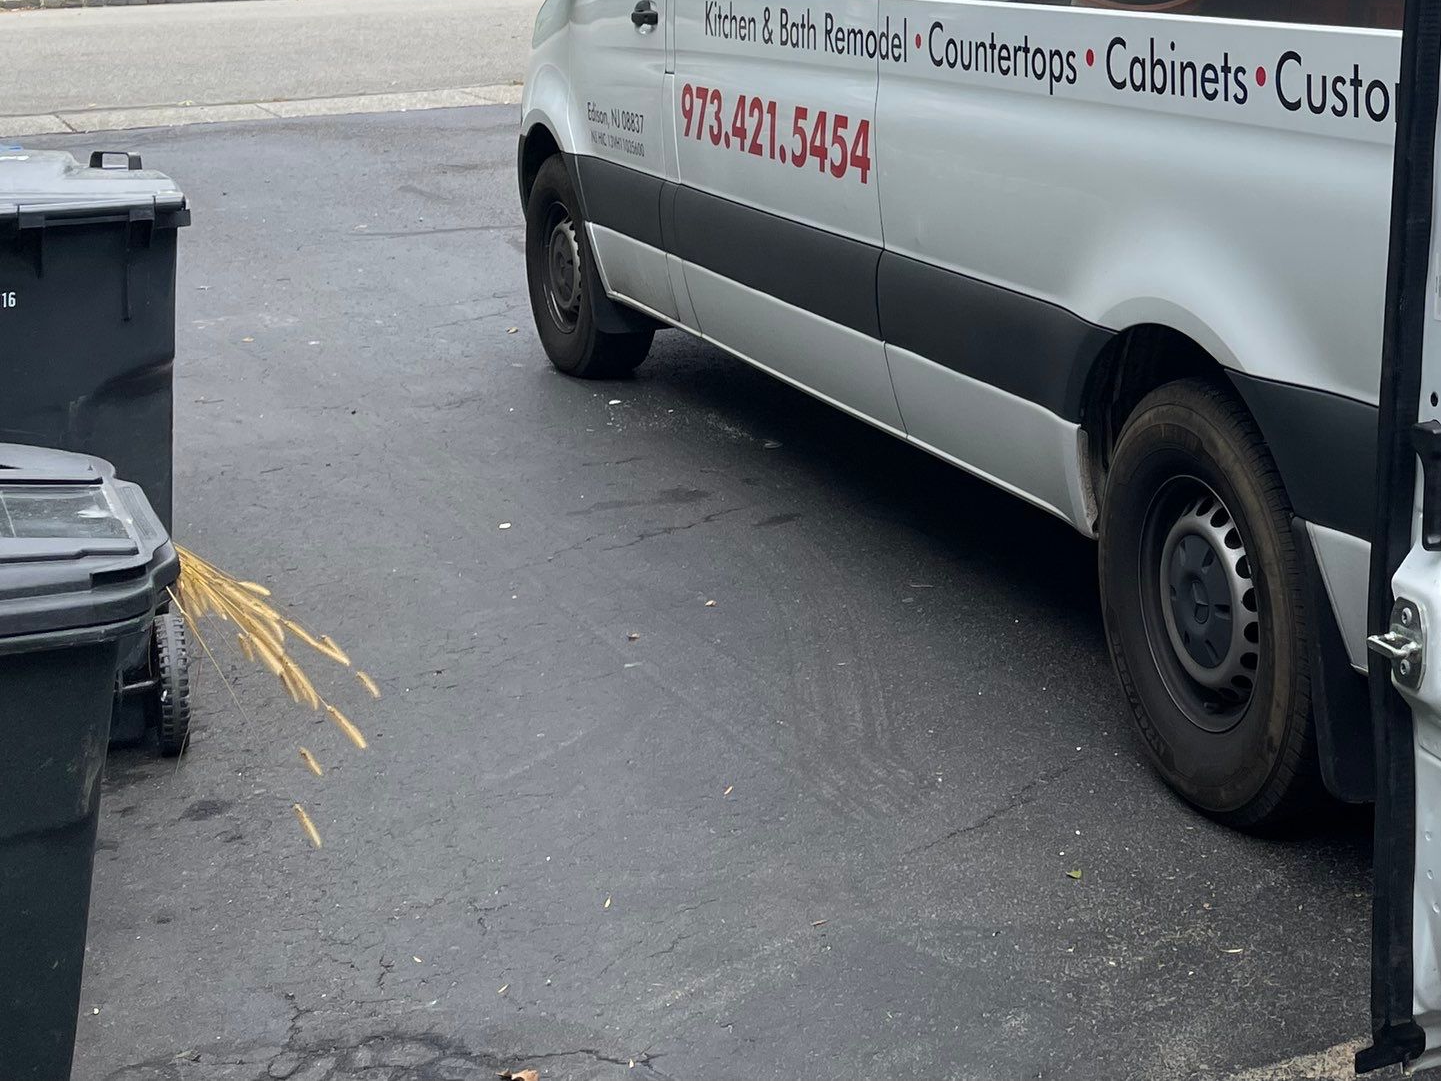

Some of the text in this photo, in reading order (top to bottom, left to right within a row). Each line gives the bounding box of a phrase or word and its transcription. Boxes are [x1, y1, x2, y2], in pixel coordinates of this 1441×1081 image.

[704, 1, 1400, 123] Kitchen & Bath Remodel Countertops Cabinets Custo
[587, 101, 644, 134] Edison, NJ 08837
[681, 83, 871, 184] 973.421.5454
[1, 291, 16, 308] 16
